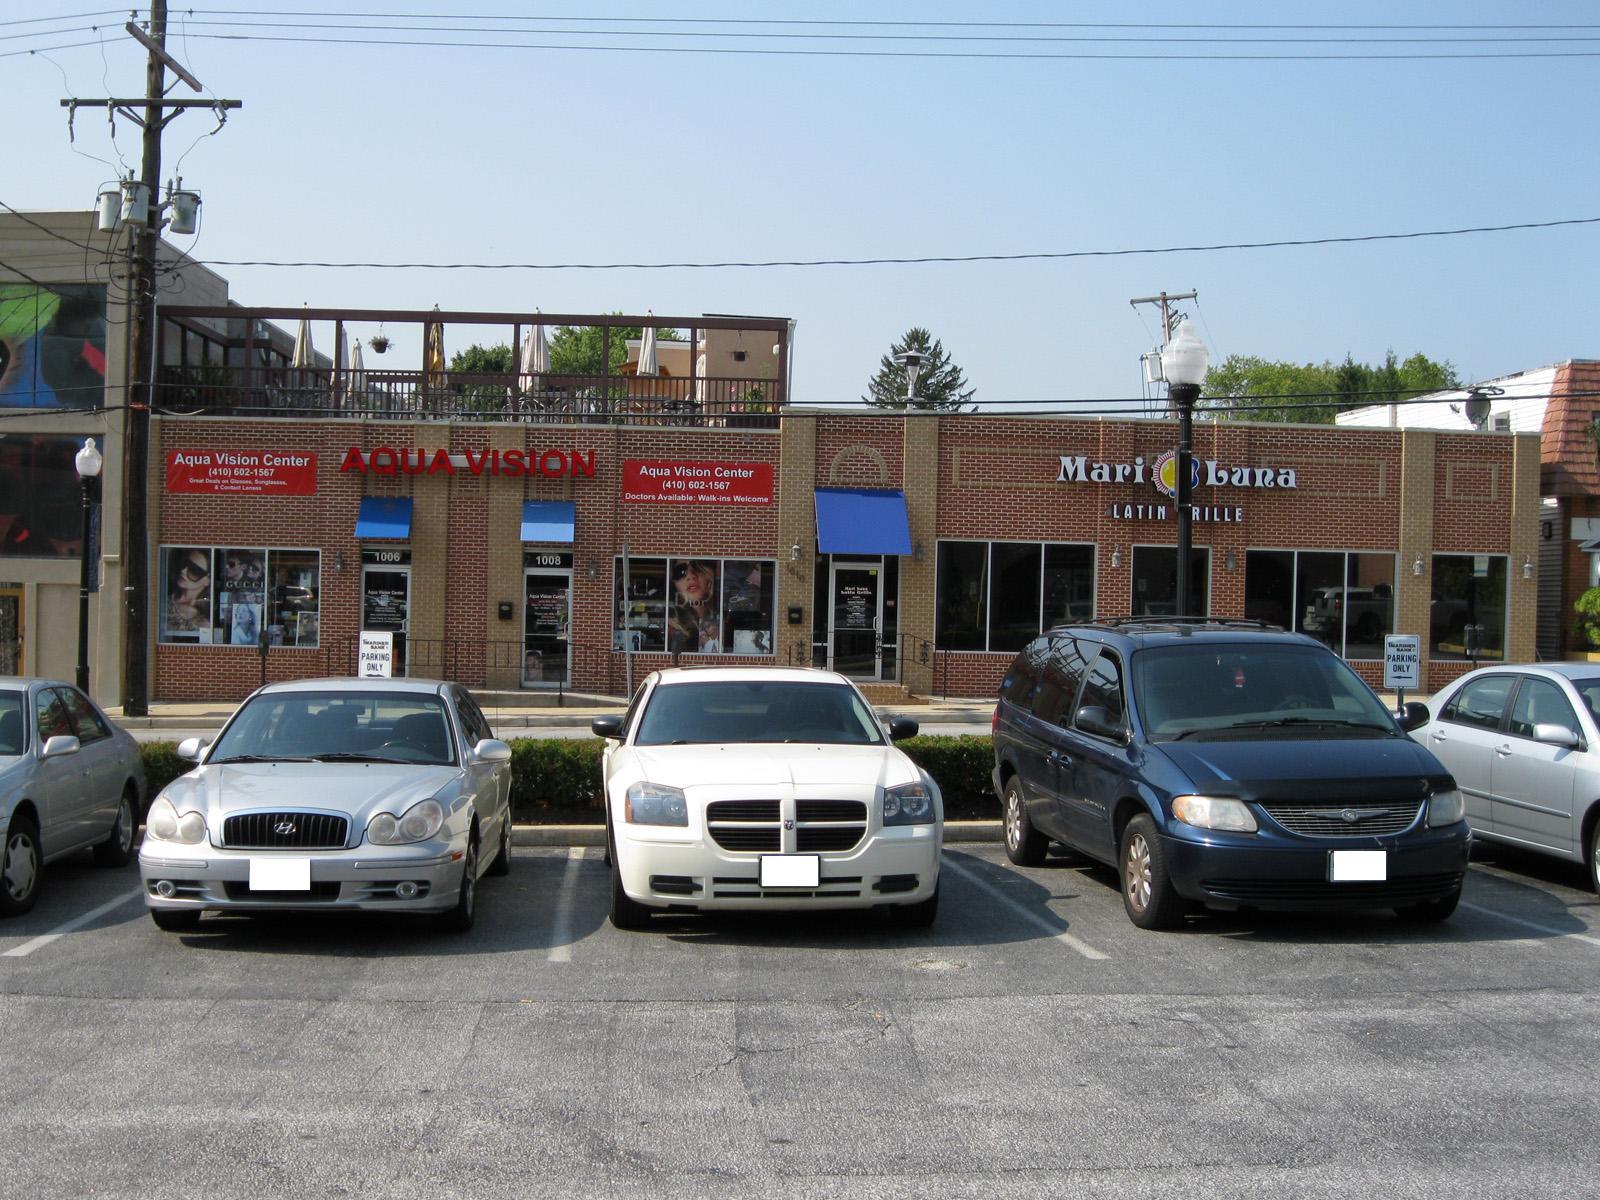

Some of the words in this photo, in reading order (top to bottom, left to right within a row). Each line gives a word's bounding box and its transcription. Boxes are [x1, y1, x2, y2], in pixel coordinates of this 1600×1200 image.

[175, 453, 211, 467] Aqua
[215, 453, 259, 465] Vision
[263, 454, 310, 467] Center
[340, 447, 456, 478] AQUA
[465, 448, 595, 478] VISION
[208, 467, 232, 478] (410)
[234, 468, 275, 477] 602-1567
[639, 465, 671, 478] Aqua
[674, 466, 711, 477] Vision
[714, 467, 754, 478] Center
[1057, 455, 1145, 483] Mari
[1205, 460, 1297, 488] Luna
[662, 480, 686, 490] (410)
[688, 480, 730, 490] 602-1567
[625, 493, 656, 501] Doctors
[698, 494, 731, 502] Walk-ins
[733, 495, 769, 503] Welcome
[1113, 504, 1166, 520] LATIN
[1191, 506, 1243, 521] RILLE
[375, 551, 400, 562] 1006
[536, 555, 561, 566] 1008
[226, 580, 264, 588] GUCCI
[361, 652, 390, 662] PARKING
[1387, 654, 1417, 663] PARKING
[367, 662, 384, 672] ONLY
[1392, 664, 1411, 673] ONLY
